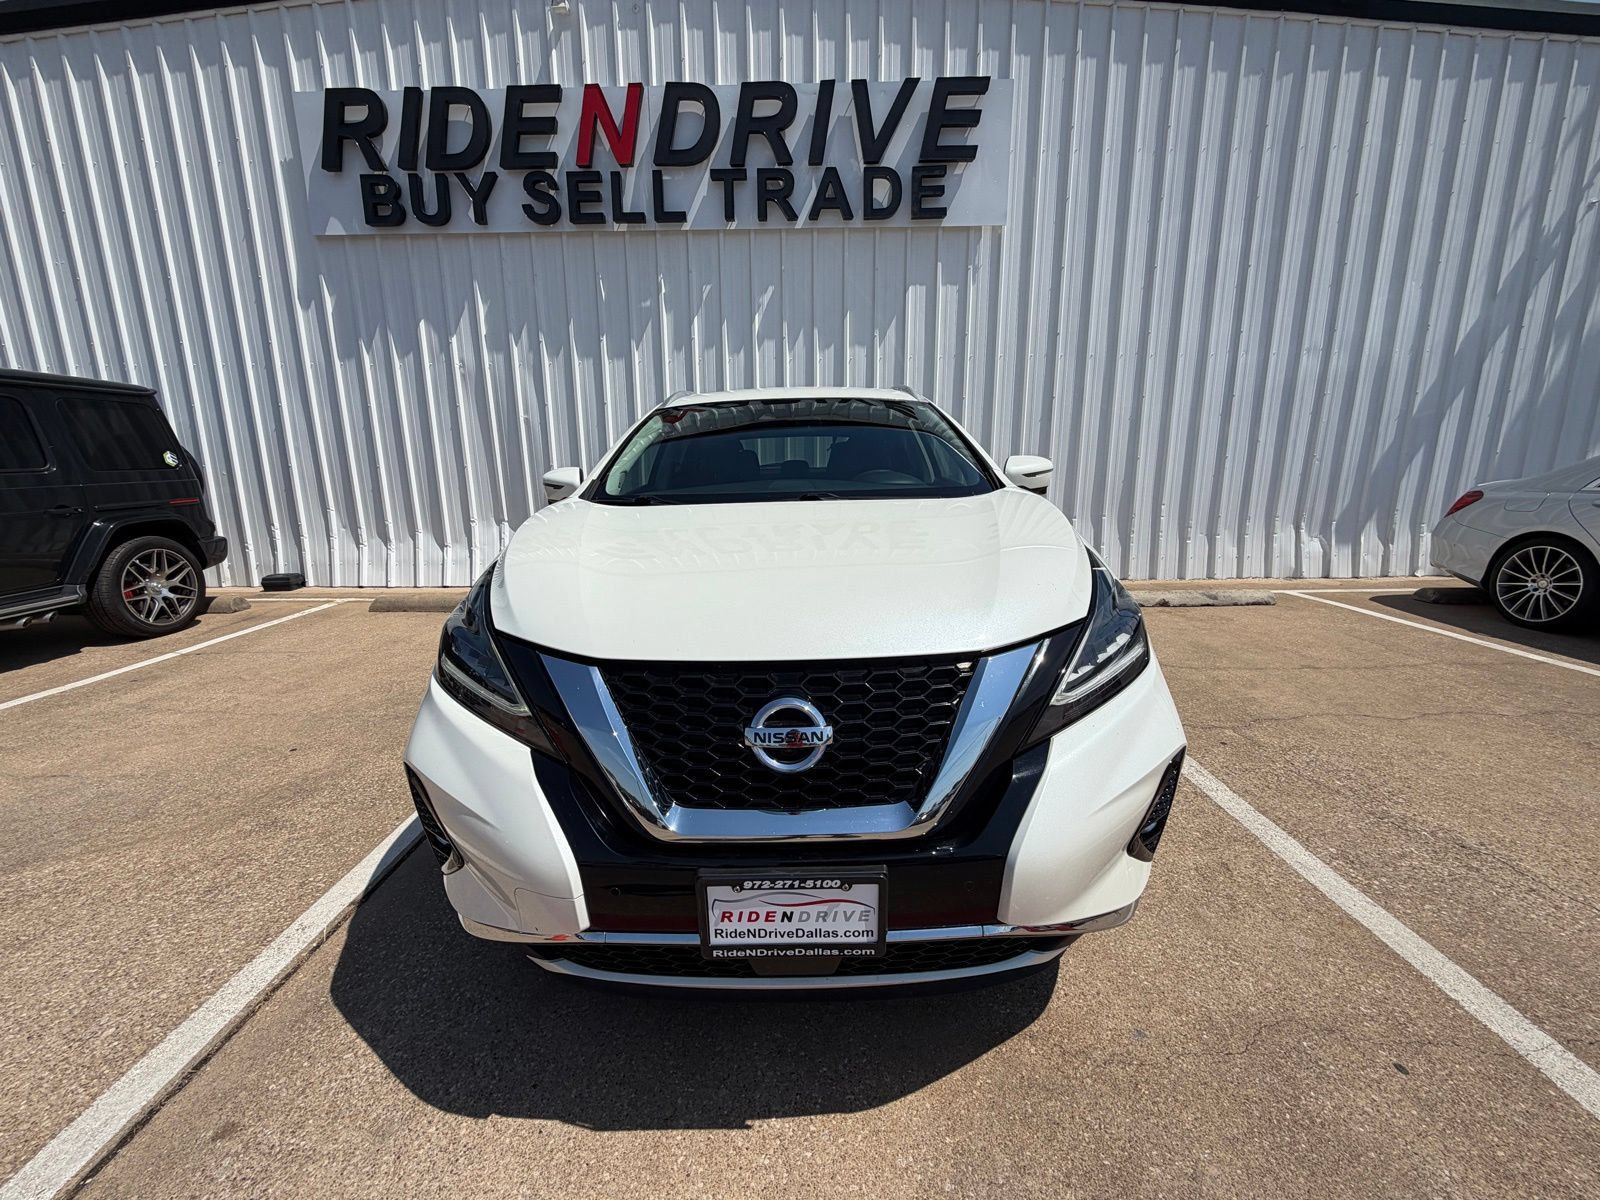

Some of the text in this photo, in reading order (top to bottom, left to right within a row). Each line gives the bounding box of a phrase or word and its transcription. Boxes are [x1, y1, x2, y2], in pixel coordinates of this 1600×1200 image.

[321, 76, 991, 172] RIDENDRIVE
[360, 164, 949, 227] BUY SELL TRADE
[753, 731, 824, 744] NISSAN
[743, 880, 841, 889] 972-271-5100
[720, 910, 872, 923] RIDENDRIVE
[714, 928, 874, 939] RideNDriveDallas.com
[712, 948, 876, 958] RideNDriveDallas.com
